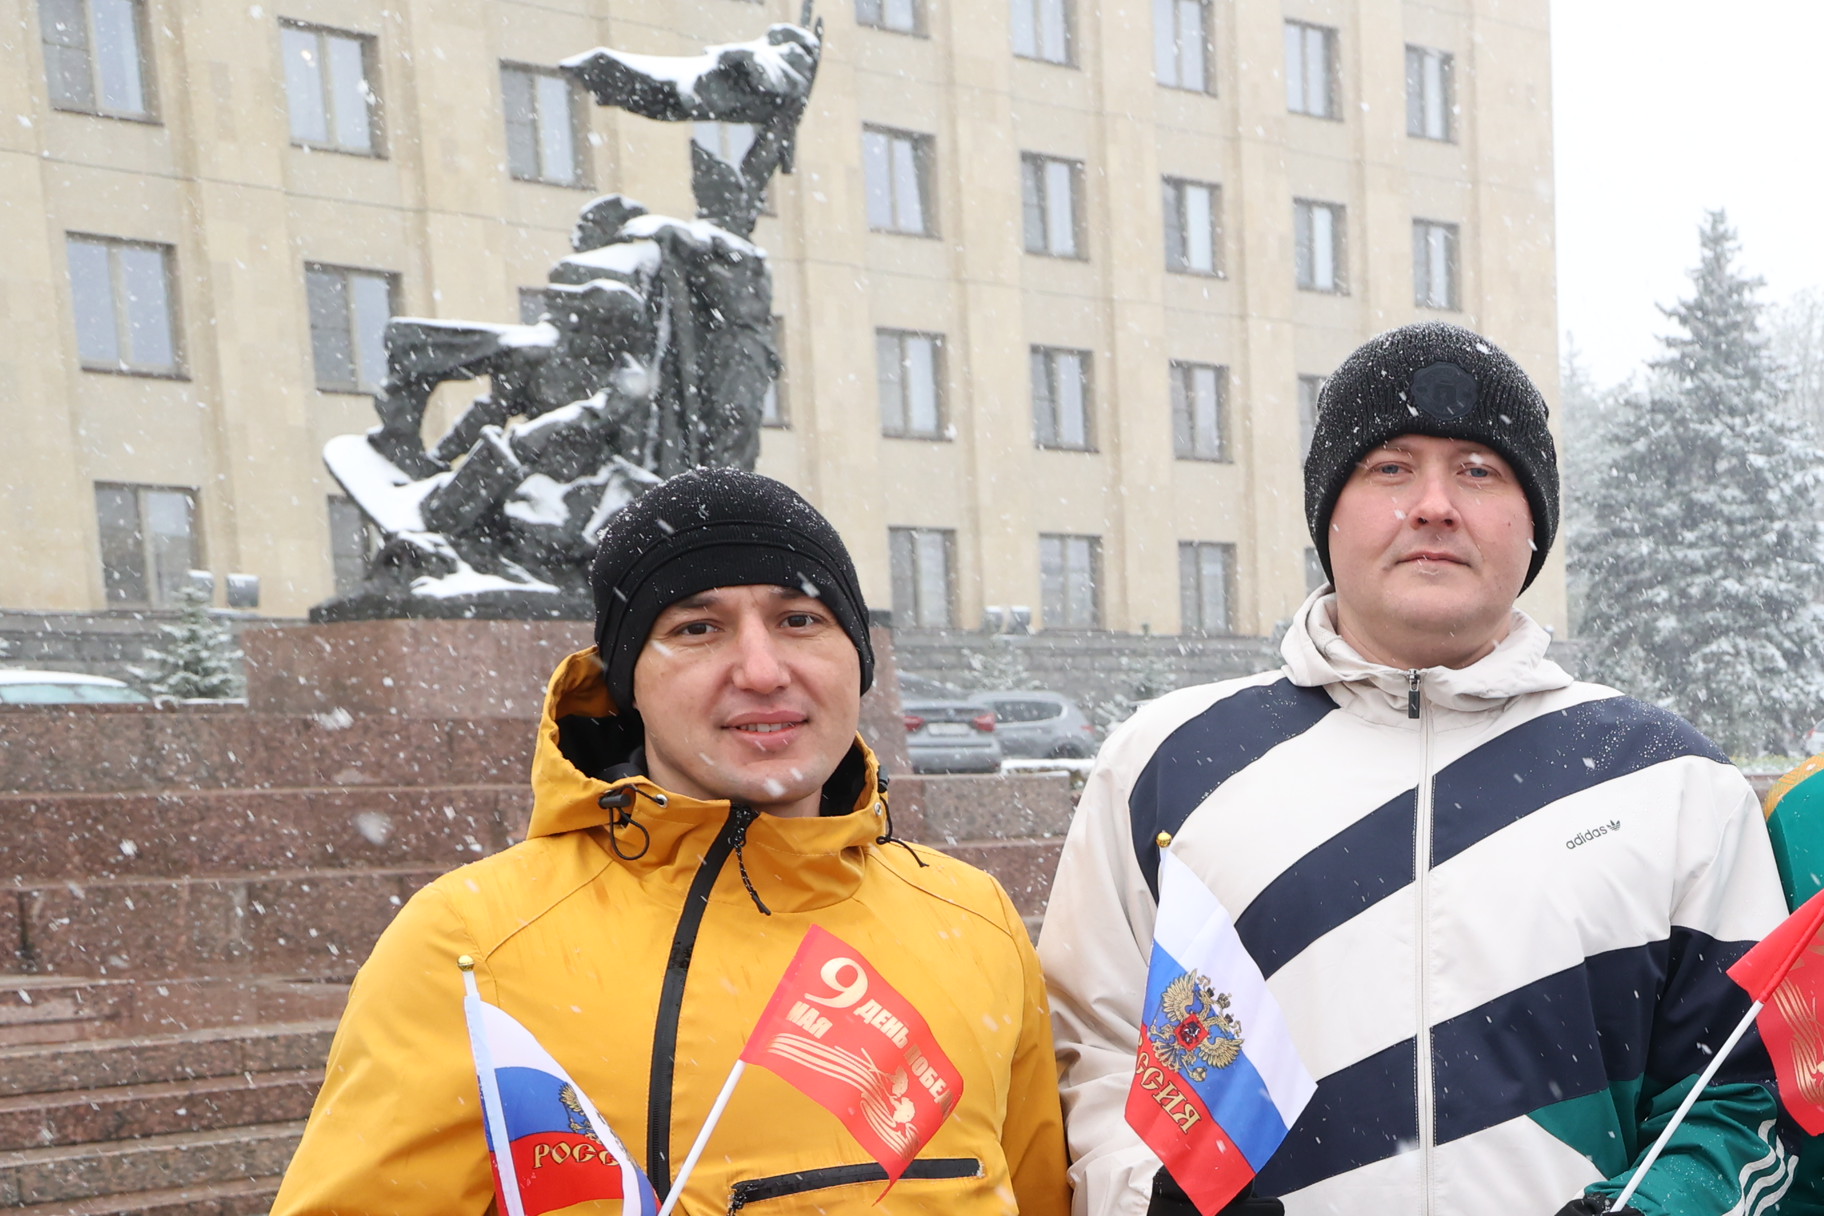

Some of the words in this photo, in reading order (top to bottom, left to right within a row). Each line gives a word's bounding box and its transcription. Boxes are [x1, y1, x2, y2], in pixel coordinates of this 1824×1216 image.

[1565, 826, 1608, 850] adidas
[804, 957, 869, 1009] 9
[786, 1001, 834, 1039] МАЯ
[853, 998, 911, 1049] ДЕНЬ
[533, 1141, 620, 1169] РОСС
